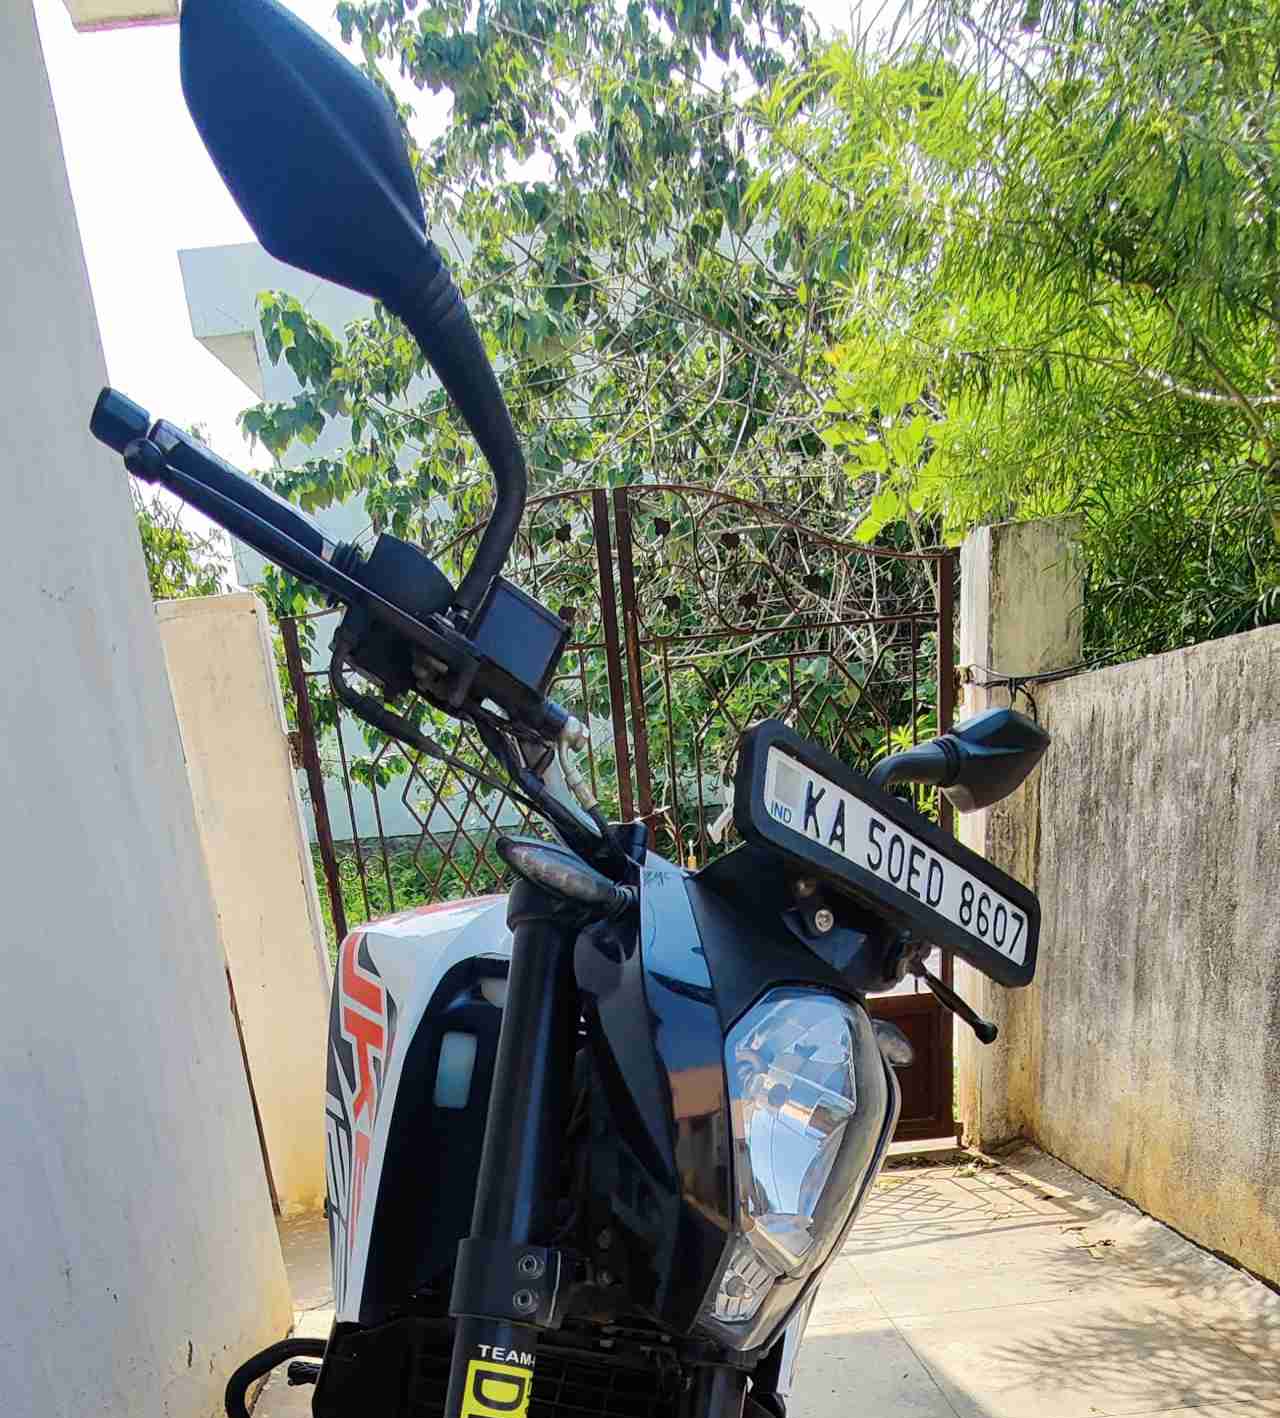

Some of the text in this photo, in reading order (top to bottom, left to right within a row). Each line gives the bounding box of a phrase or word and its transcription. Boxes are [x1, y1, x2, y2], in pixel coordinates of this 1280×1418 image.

[770, 799, 793, 825] IND
[803, 780, 1025, 955] KA 50ED 8607
